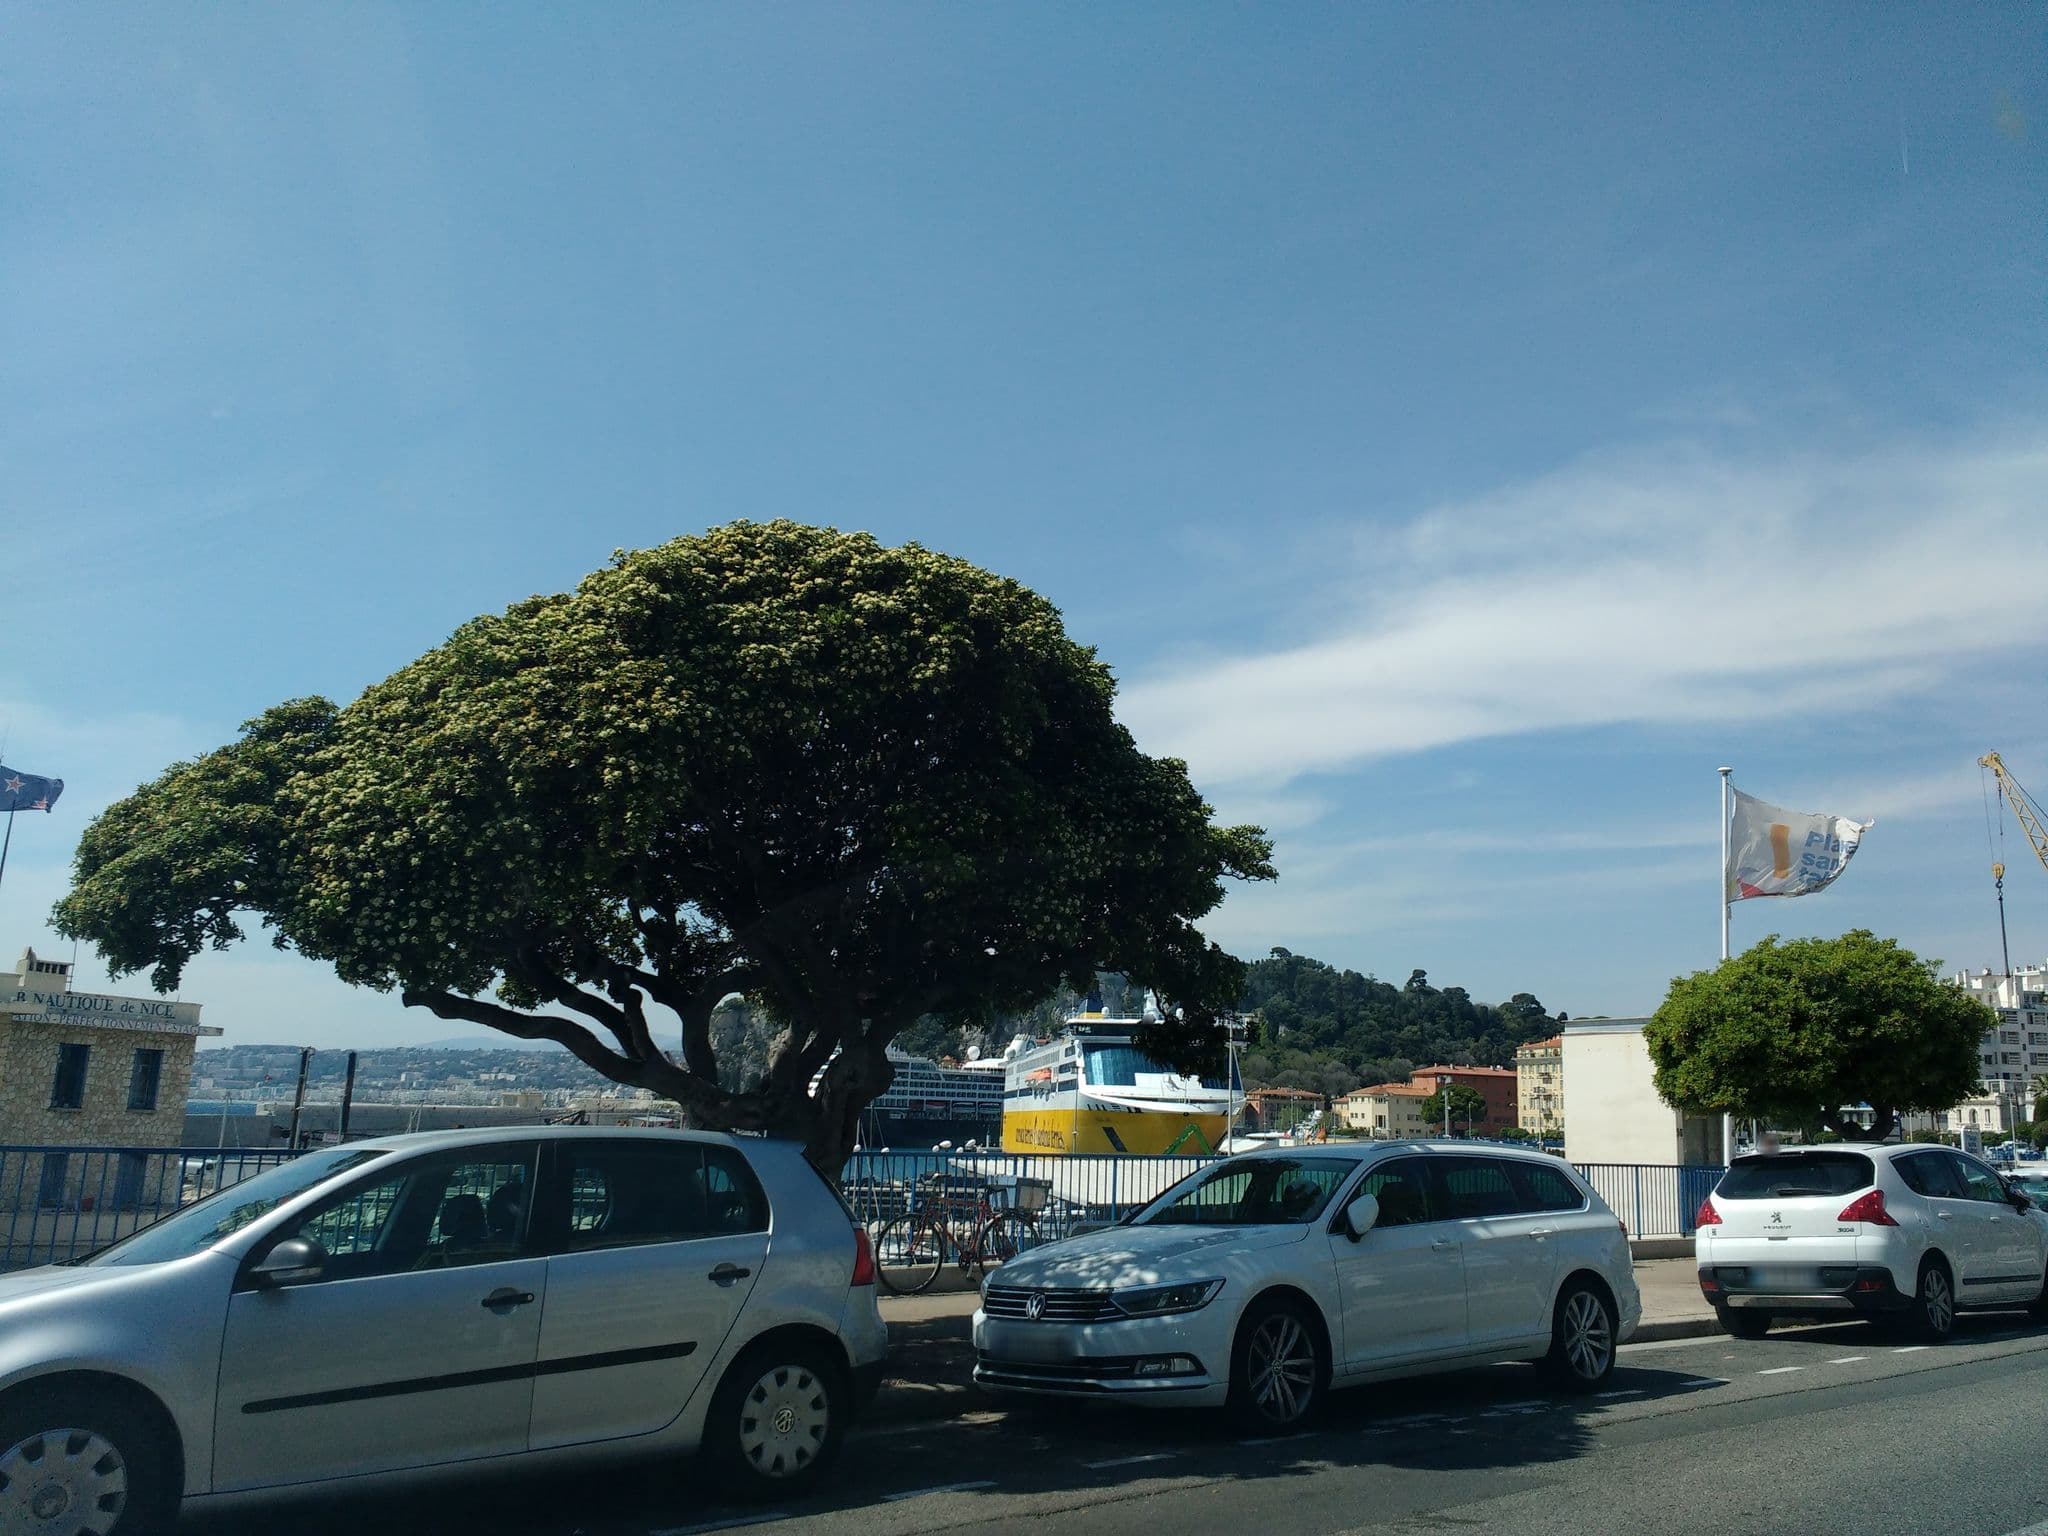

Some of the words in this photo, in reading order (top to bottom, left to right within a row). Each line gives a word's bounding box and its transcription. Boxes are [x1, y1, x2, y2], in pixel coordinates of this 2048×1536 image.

[33, 992, 113, 1011] NAUTIQUE
[120, 1001, 134, 1013] de
[140, 1002, 174, 1018] NICE
